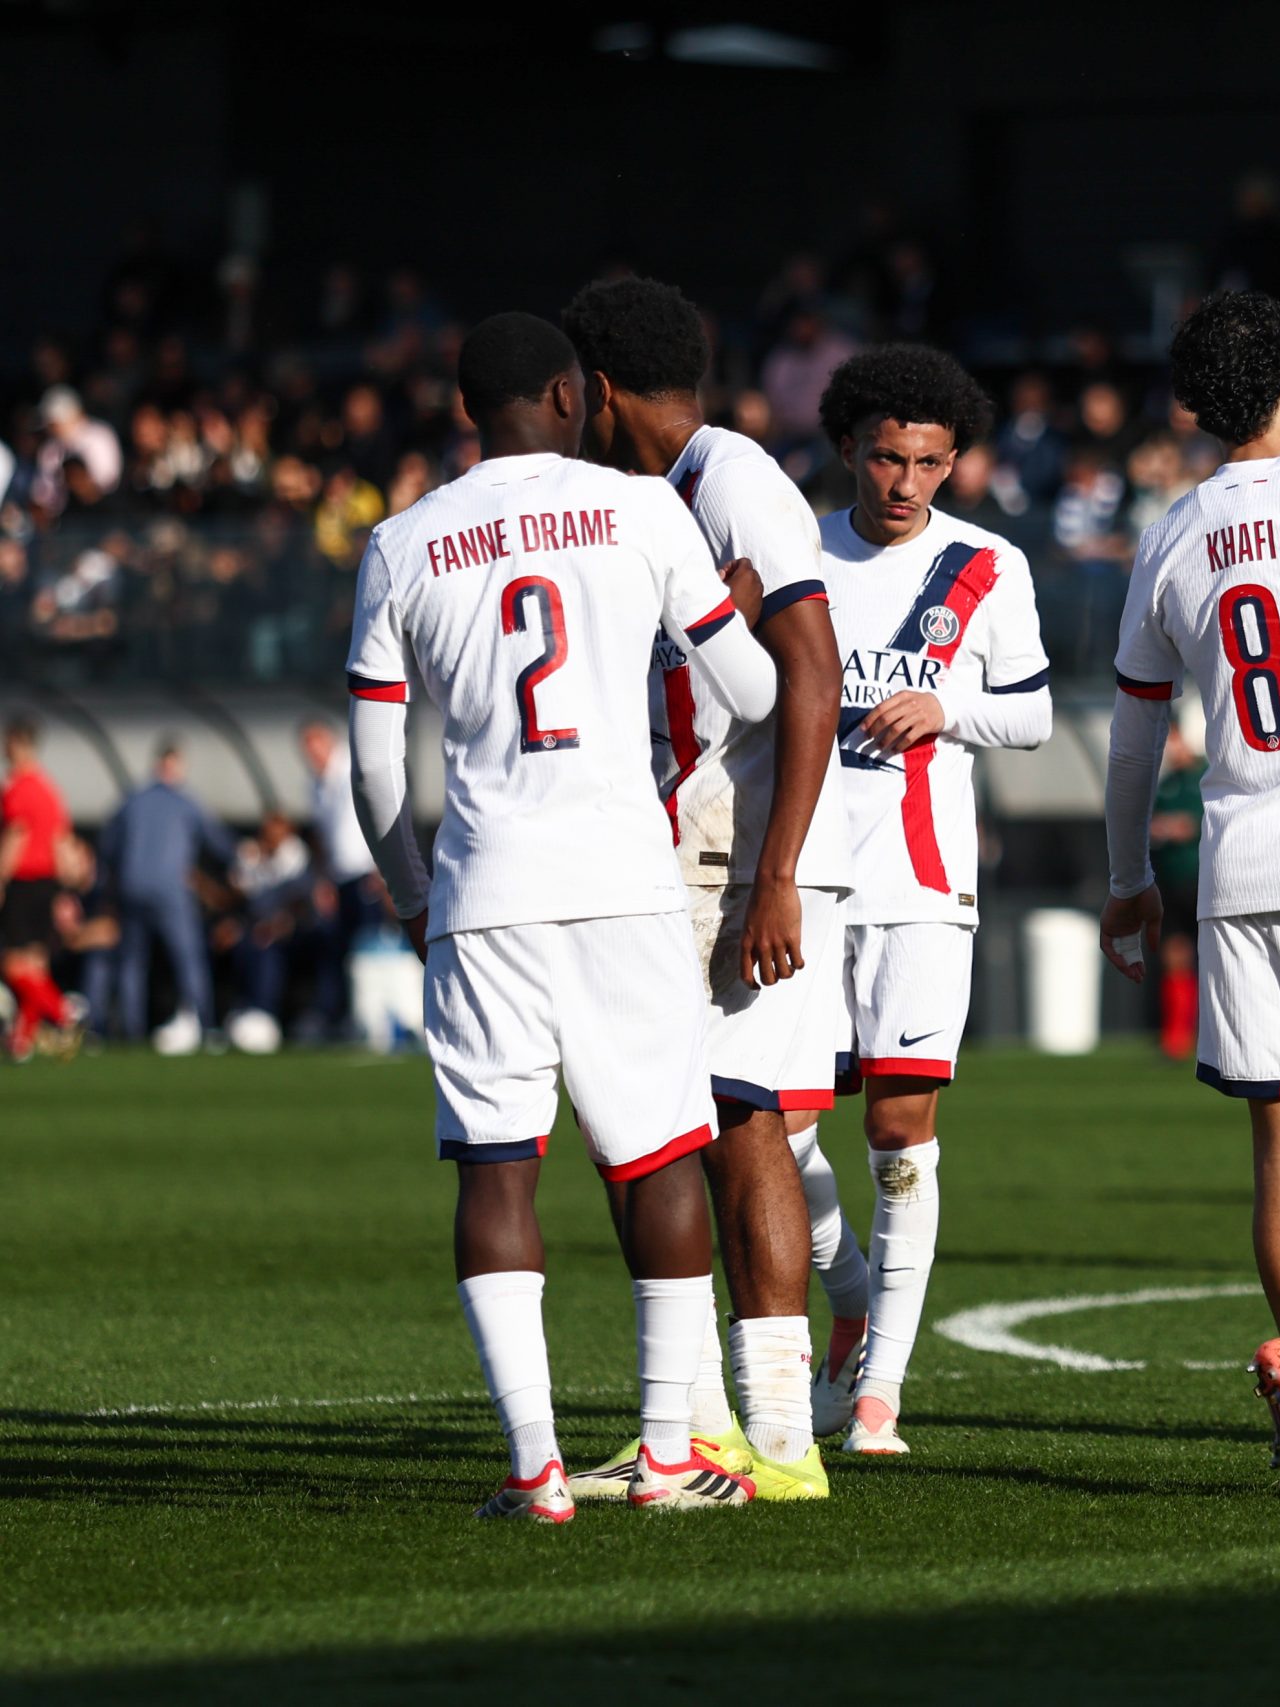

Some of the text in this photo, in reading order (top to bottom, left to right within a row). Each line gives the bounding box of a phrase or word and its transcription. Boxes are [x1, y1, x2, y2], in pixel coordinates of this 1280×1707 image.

[427, 509, 619, 577] FANNE DRAME
[1206, 519, 1277, 573] KHAFI
[500, 575, 581, 755] 2
[842, 648, 942, 690] ATAR
